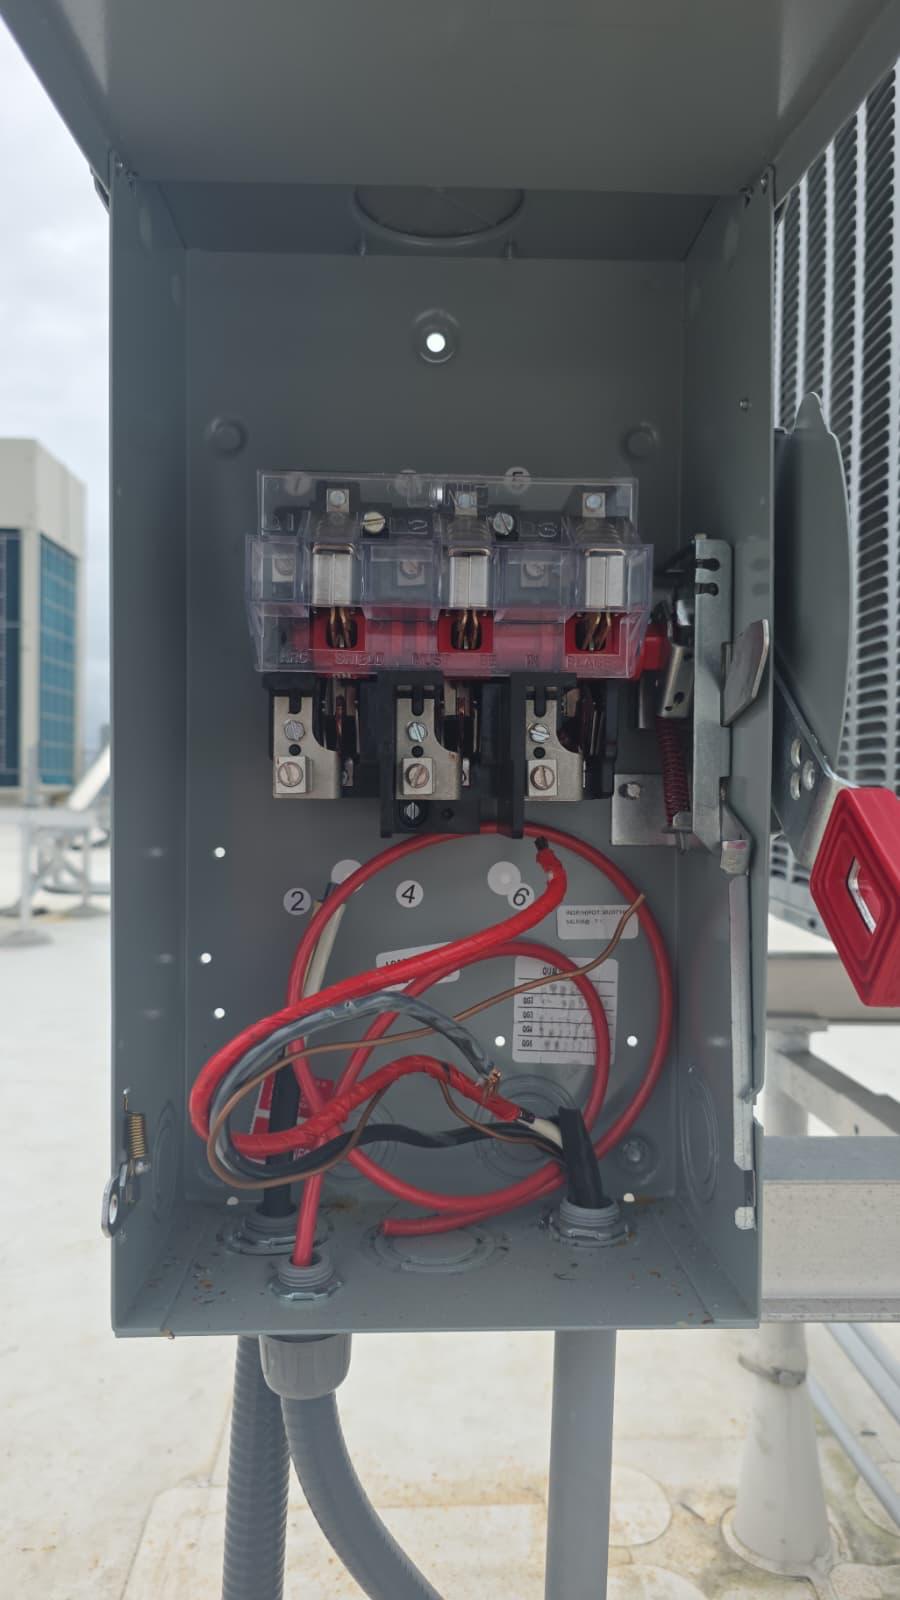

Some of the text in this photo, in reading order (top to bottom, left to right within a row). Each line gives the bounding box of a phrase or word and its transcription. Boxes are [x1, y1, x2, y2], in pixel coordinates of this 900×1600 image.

[291, 891, 305, 911] 2
[402, 885, 416, 904] 4
[513, 887, 530, 906] 6
